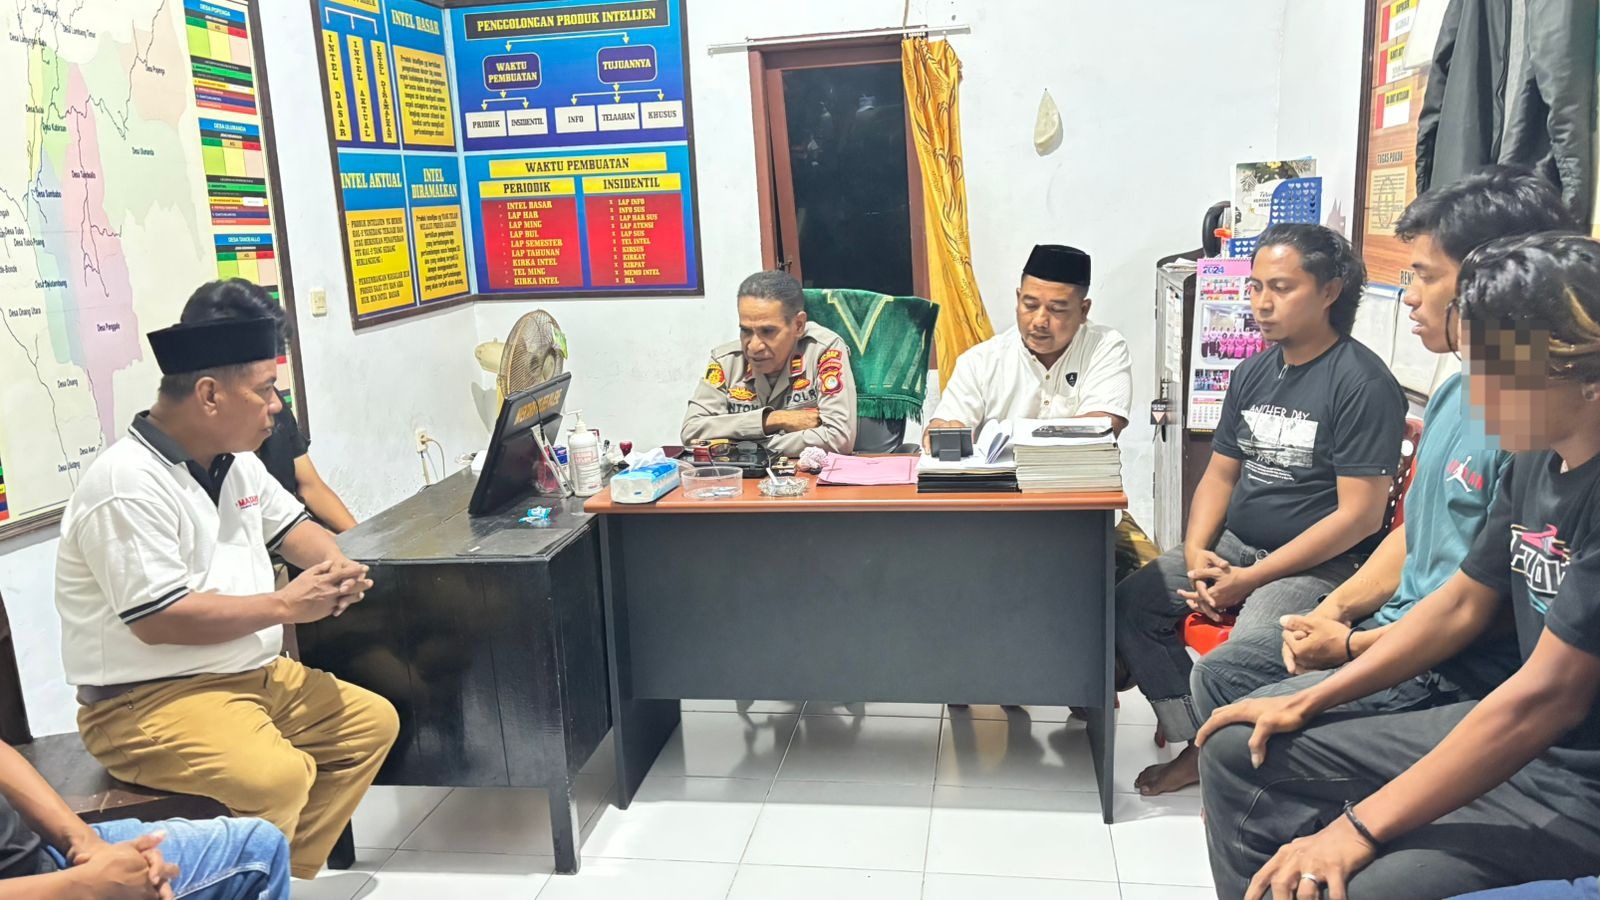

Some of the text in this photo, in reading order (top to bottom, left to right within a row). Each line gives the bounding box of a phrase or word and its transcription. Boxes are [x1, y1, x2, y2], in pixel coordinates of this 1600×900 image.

[392, 10, 440, 35] INTEL DASAR
[477, 8, 656, 31] PENGGOLONGAN PRODUK INTELIJEN
[496, 61, 527, 72] WAKTU
[602, 59, 651, 70] TUJUANNYA
[488, 72, 537, 83] PEMBUATAN
[328, 35, 346, 136] INTEL DASAR
[353, 41, 370, 136] INTEL AKTUAL
[602, 113, 635, 121] TELAAHAN
[1377, 152, 1389, 164] TUGAS
[525, 158, 629, 172] WAKTU PEMBUATAN
[340, 173, 402, 188] INTEL AKTUAL
[423, 168, 444, 182] INTEL
[503, 182, 551, 193] PERIODIK
[603, 178, 660, 189] INSIDENTIL
[412, 184, 457, 198] DIRAMALKAN
[507, 201, 527, 209] INTEL
[1291, 409, 1310, 420] DAY
